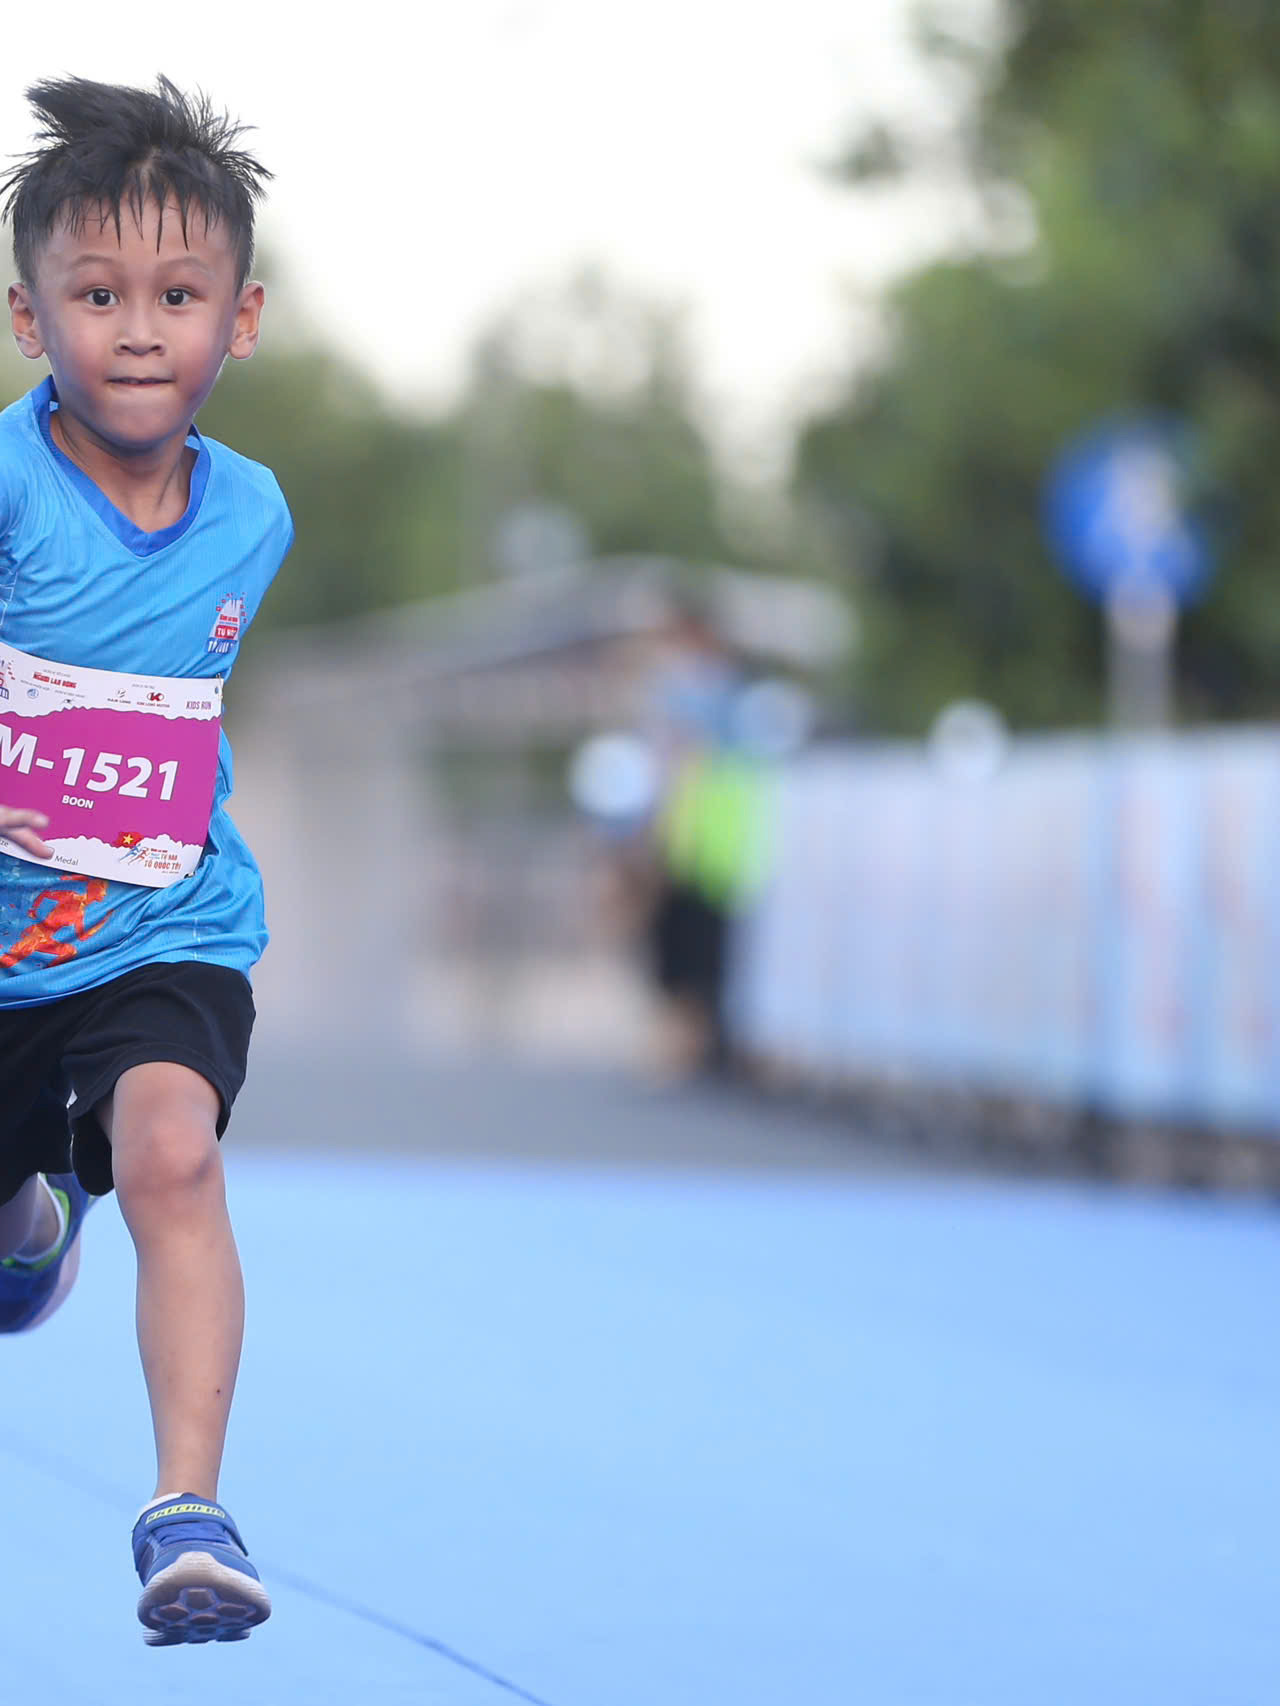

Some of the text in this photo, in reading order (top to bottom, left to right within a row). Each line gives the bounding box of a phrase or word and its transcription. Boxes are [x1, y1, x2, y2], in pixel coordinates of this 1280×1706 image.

[186, 700, 212, 710] KIDS RUN
[62, 795, 95, 809] BOON
[55, 855, 79, 866] Medal
